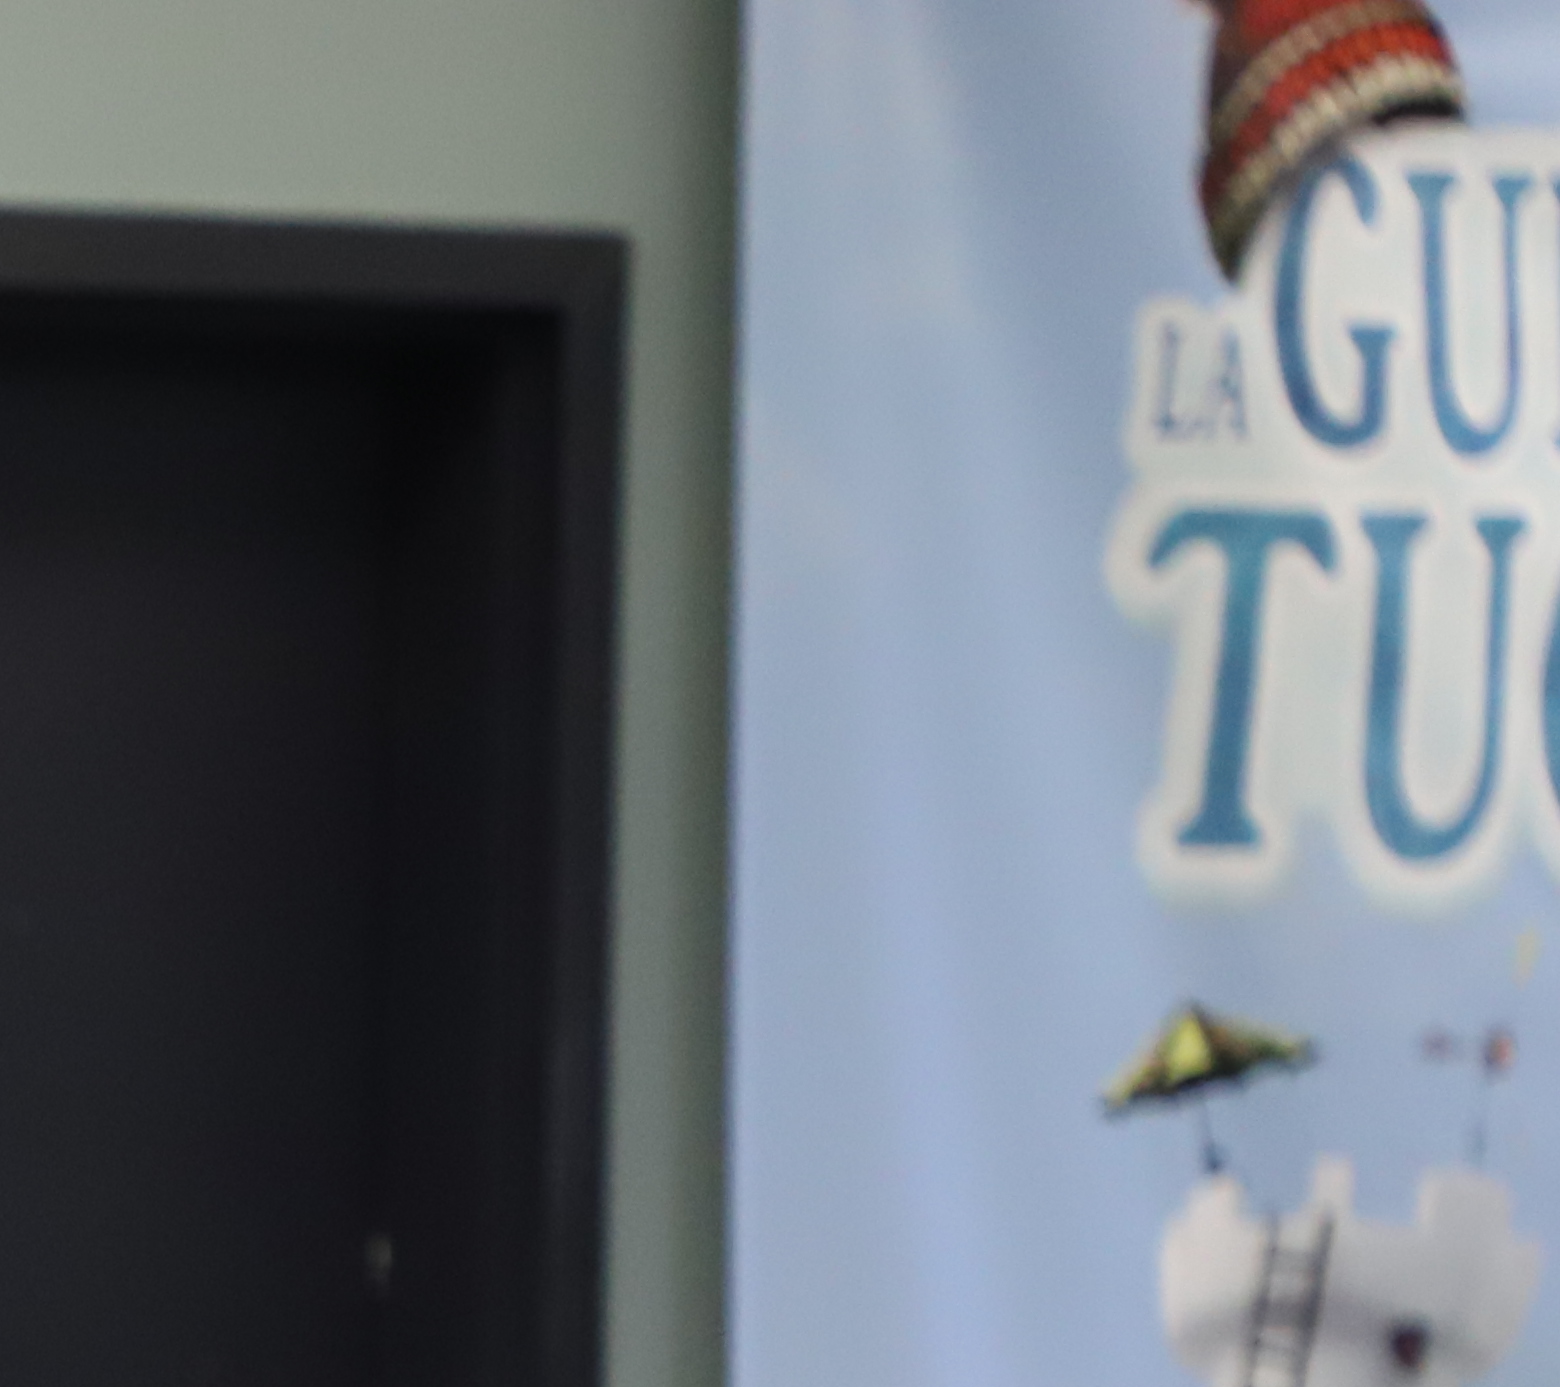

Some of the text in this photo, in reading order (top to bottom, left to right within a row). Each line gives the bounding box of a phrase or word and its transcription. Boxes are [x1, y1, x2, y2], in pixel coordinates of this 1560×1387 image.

[1153, 158, 1560, 455] LA GU
[1149, 510, 1560, 861] TU
